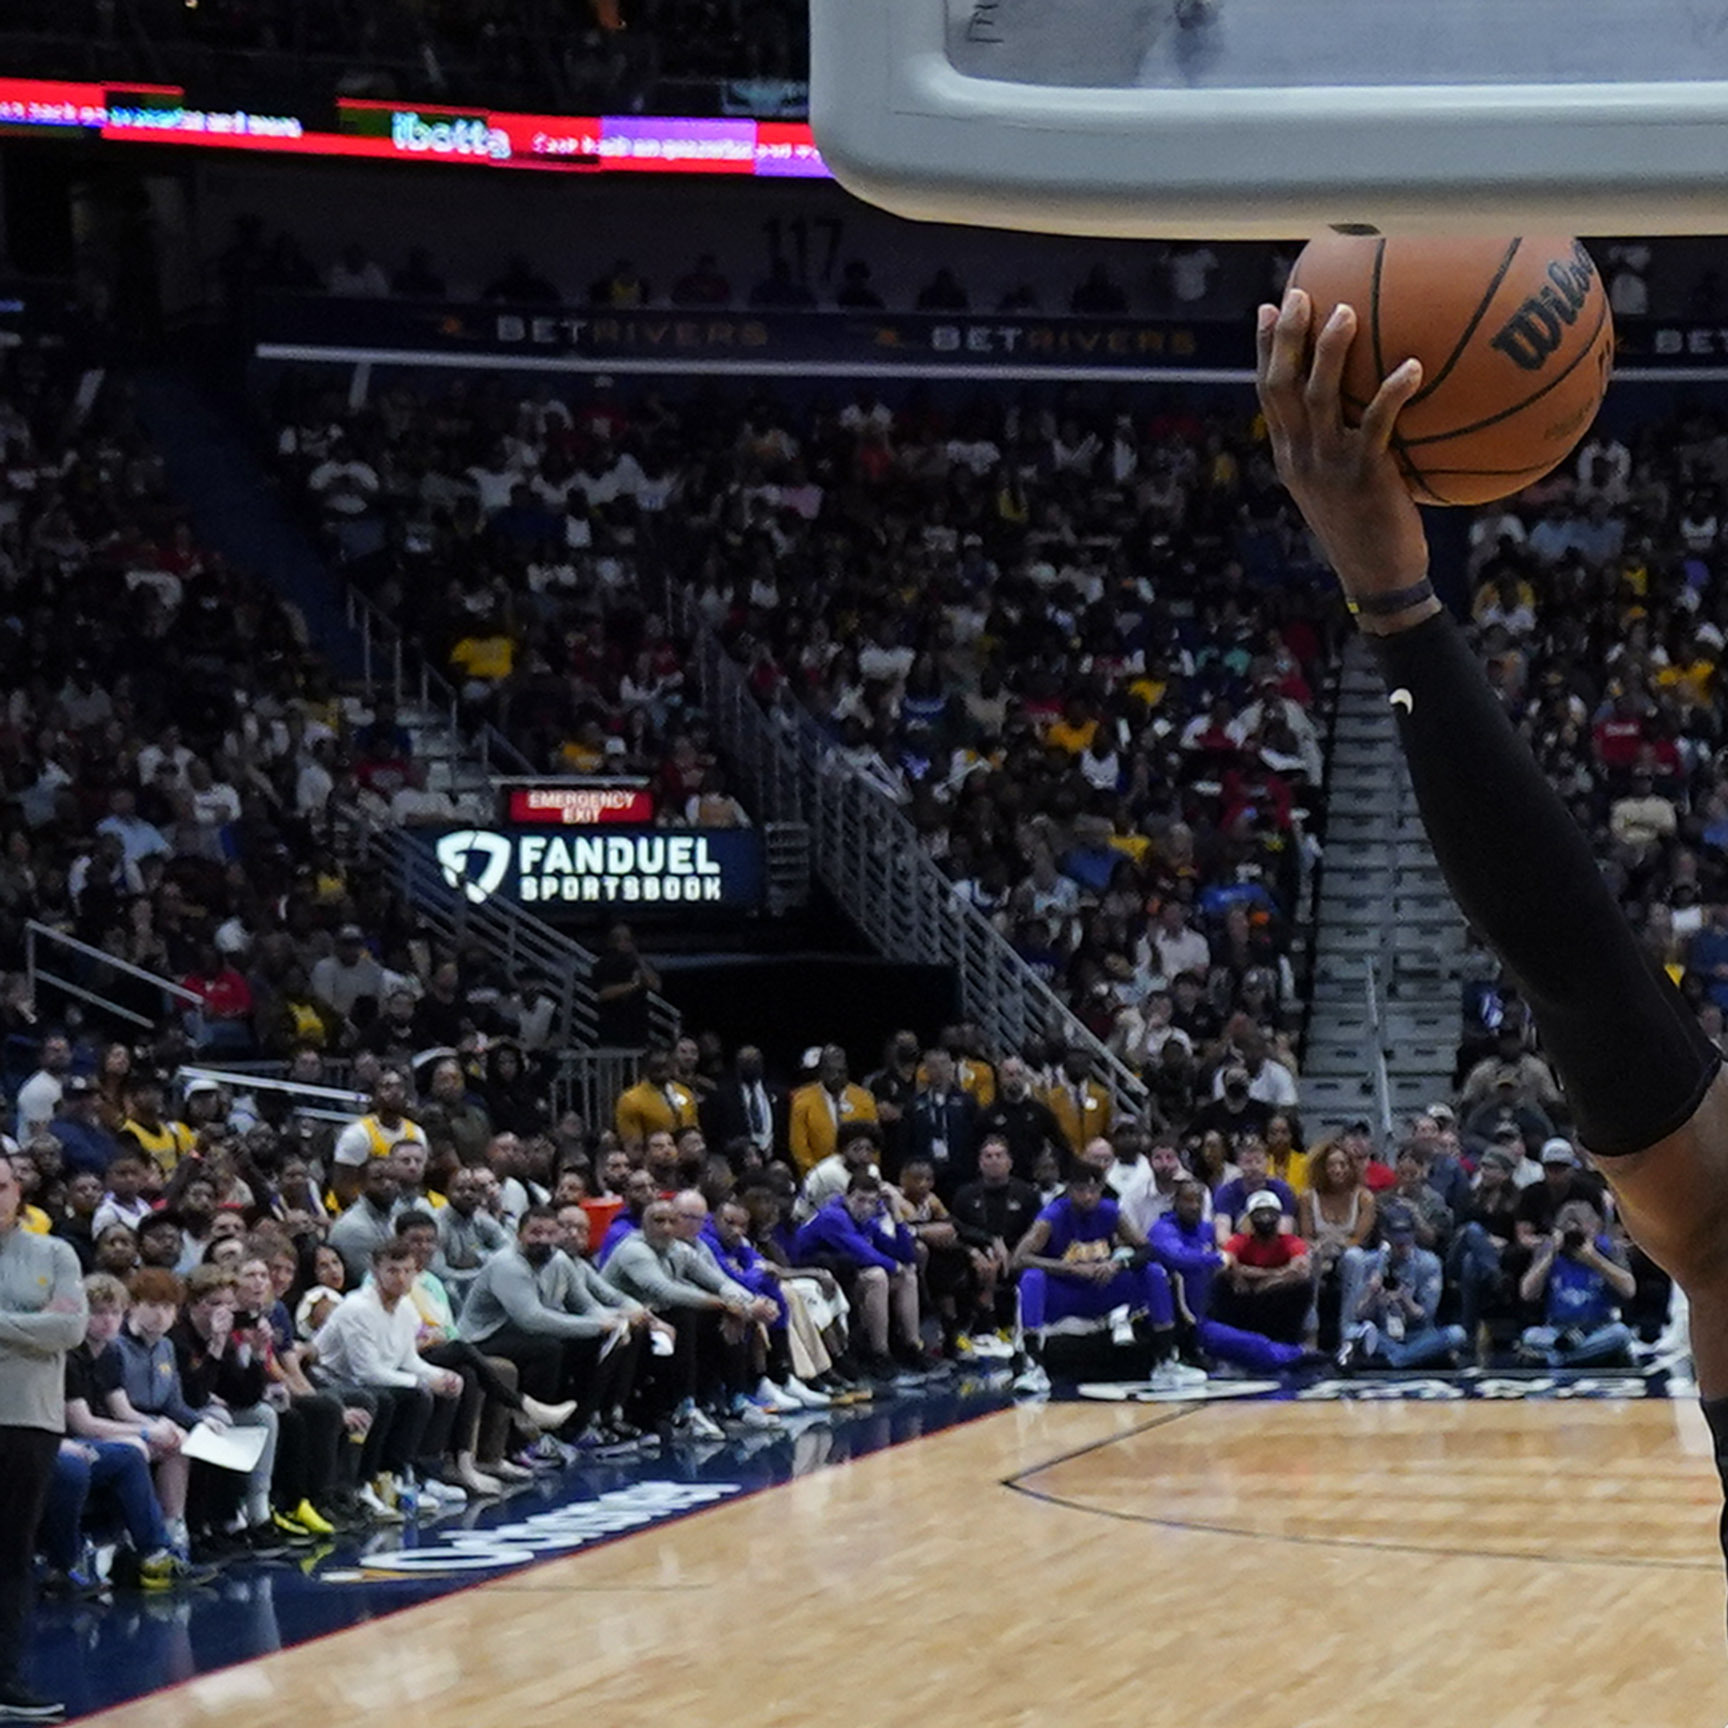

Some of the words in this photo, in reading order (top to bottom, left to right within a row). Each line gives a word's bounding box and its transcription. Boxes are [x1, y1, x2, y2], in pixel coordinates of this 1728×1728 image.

[391, 110, 511, 158] ibotta
[497, 314, 768, 347] BETRIVERS
[930, 324, 1198, 357] BETRIVERS
[528, 790, 635, 810] EMERGENCY
[562, 808, 601, 825] EXIT
[519, 836, 721, 875] FANDUEL
[519, 875, 721, 903] SPORTSBOOK
